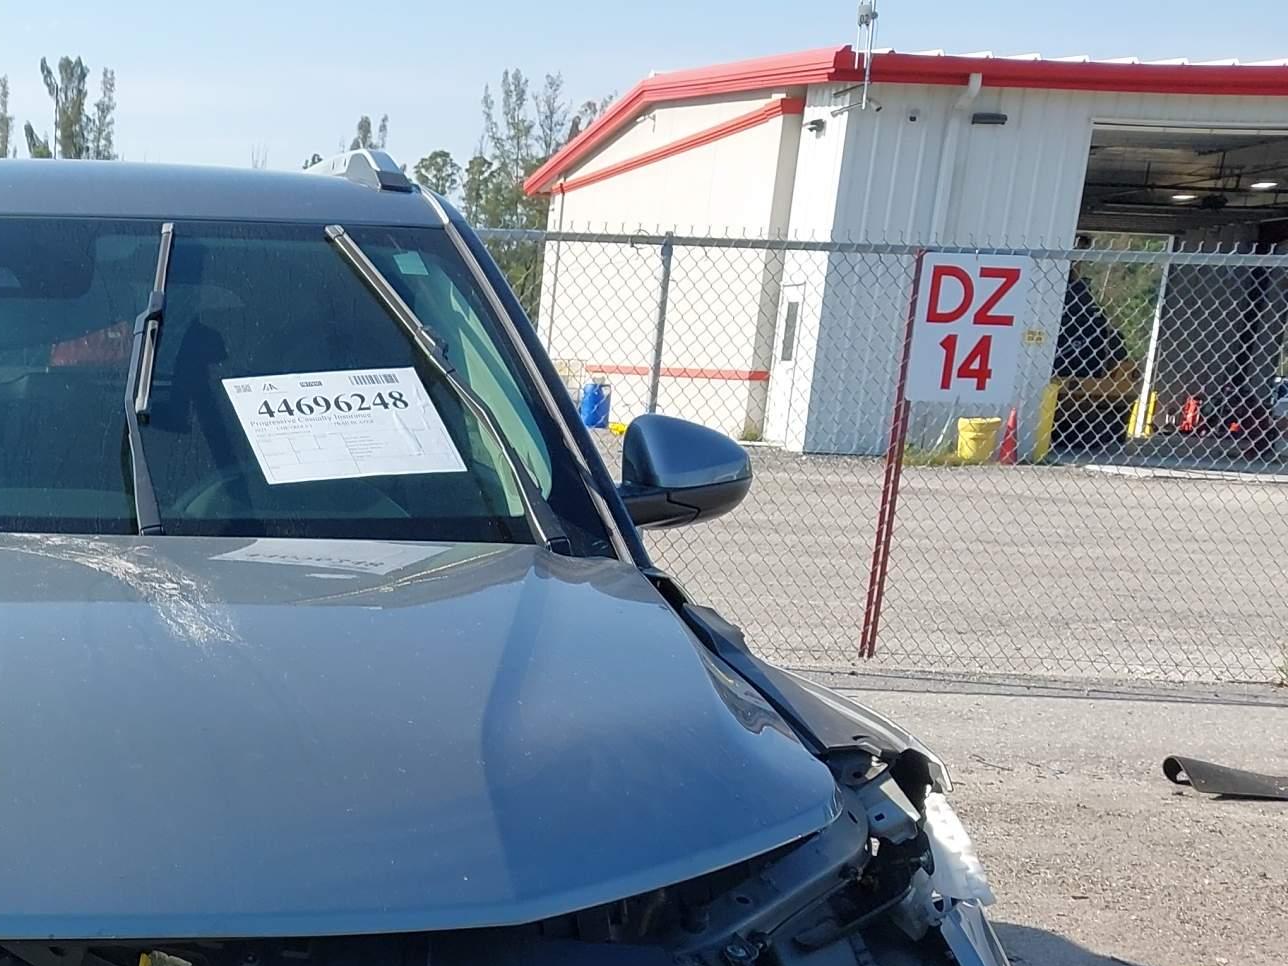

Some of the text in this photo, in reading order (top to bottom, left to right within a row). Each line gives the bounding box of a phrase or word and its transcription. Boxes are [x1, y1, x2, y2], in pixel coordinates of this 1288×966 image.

[926, 265, 1021, 327] DZ
[939, 334, 992, 391] 14
[249, 417, 297, 428] Progressive
[258, 390, 409, 418] 44696248
